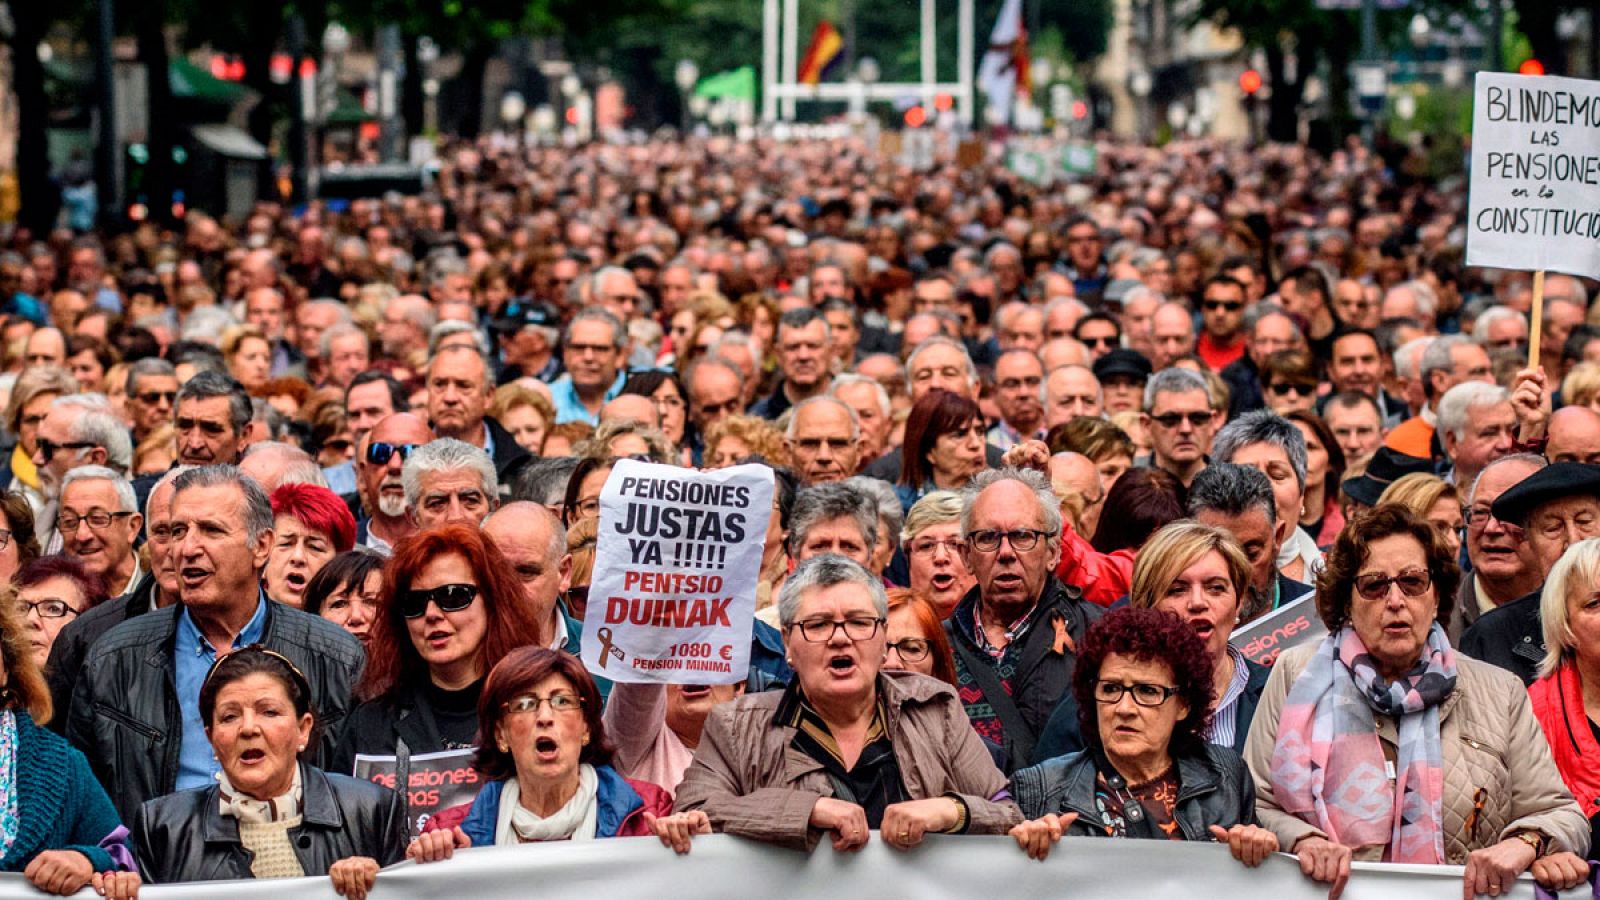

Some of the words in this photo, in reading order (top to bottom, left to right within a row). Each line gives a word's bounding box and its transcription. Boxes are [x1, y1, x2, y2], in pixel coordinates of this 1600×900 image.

[1530, 131, 1560, 146] LAS
[1511, 188, 1529, 197] en
[619, 477, 750, 508] PENSIONES
[615, 503, 746, 543] JUSTAS
[628, 539, 662, 565] YA
[673, 543, 727, 569] !!!!!
[624, 571, 723, 594] PENTSIO
[604, 596, 733, 628] DUINAK
[670, 643, 712, 657] 1080
[719, 645, 733, 660] €
[632, 658, 682, 670] PENSION
[686, 660, 732, 672] MINIMA
